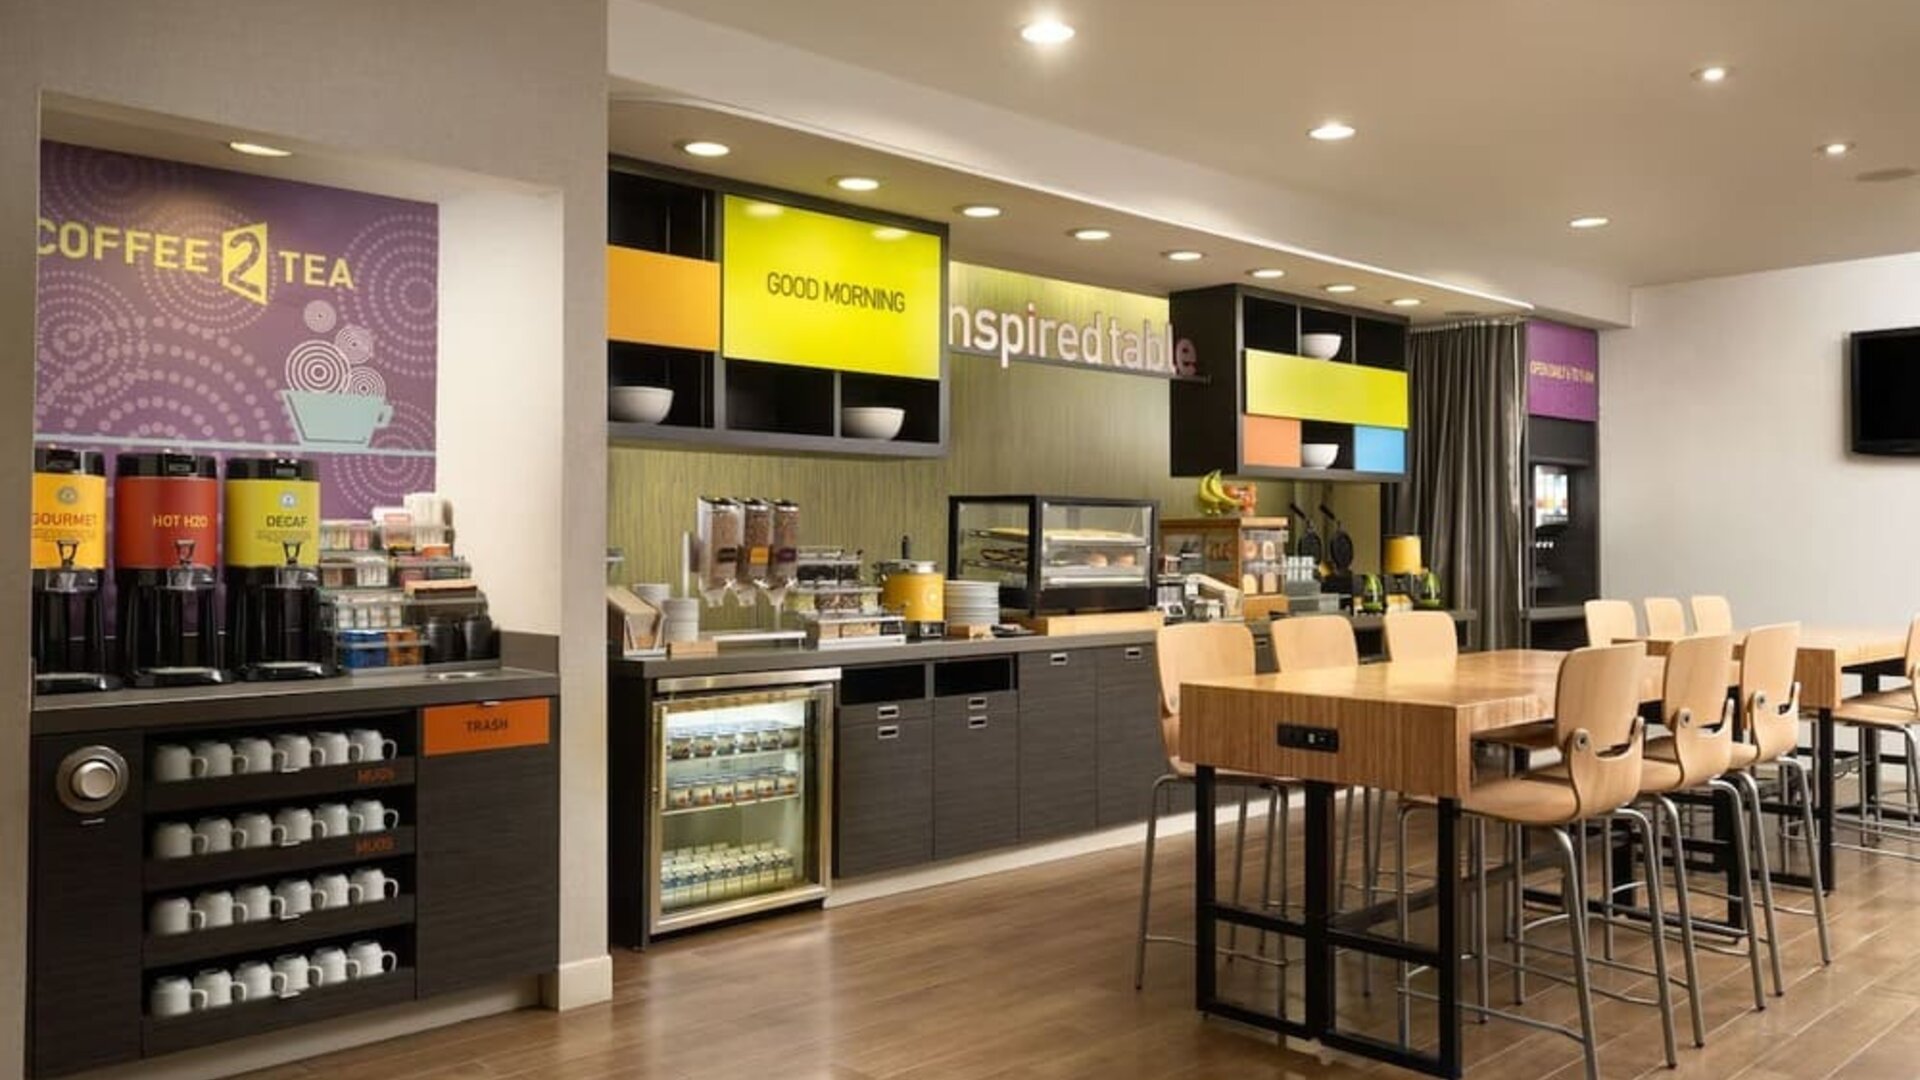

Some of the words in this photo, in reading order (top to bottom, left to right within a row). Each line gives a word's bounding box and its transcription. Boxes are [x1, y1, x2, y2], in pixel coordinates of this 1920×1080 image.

[38, 218, 209, 273] COFFEE
[226, 230, 264, 298] 2
[278, 250, 355, 290] TEA
[767, 271, 819, 301] GOOD
[823, 281, 906, 313] MORNING
[947, 302, 1101, 369] nspired
[1108, 315, 1197, 376] table
[153, 514, 180, 528] HOT
[266, 514, 308, 528] DECAF
[466, 717, 509, 733] TRASH
